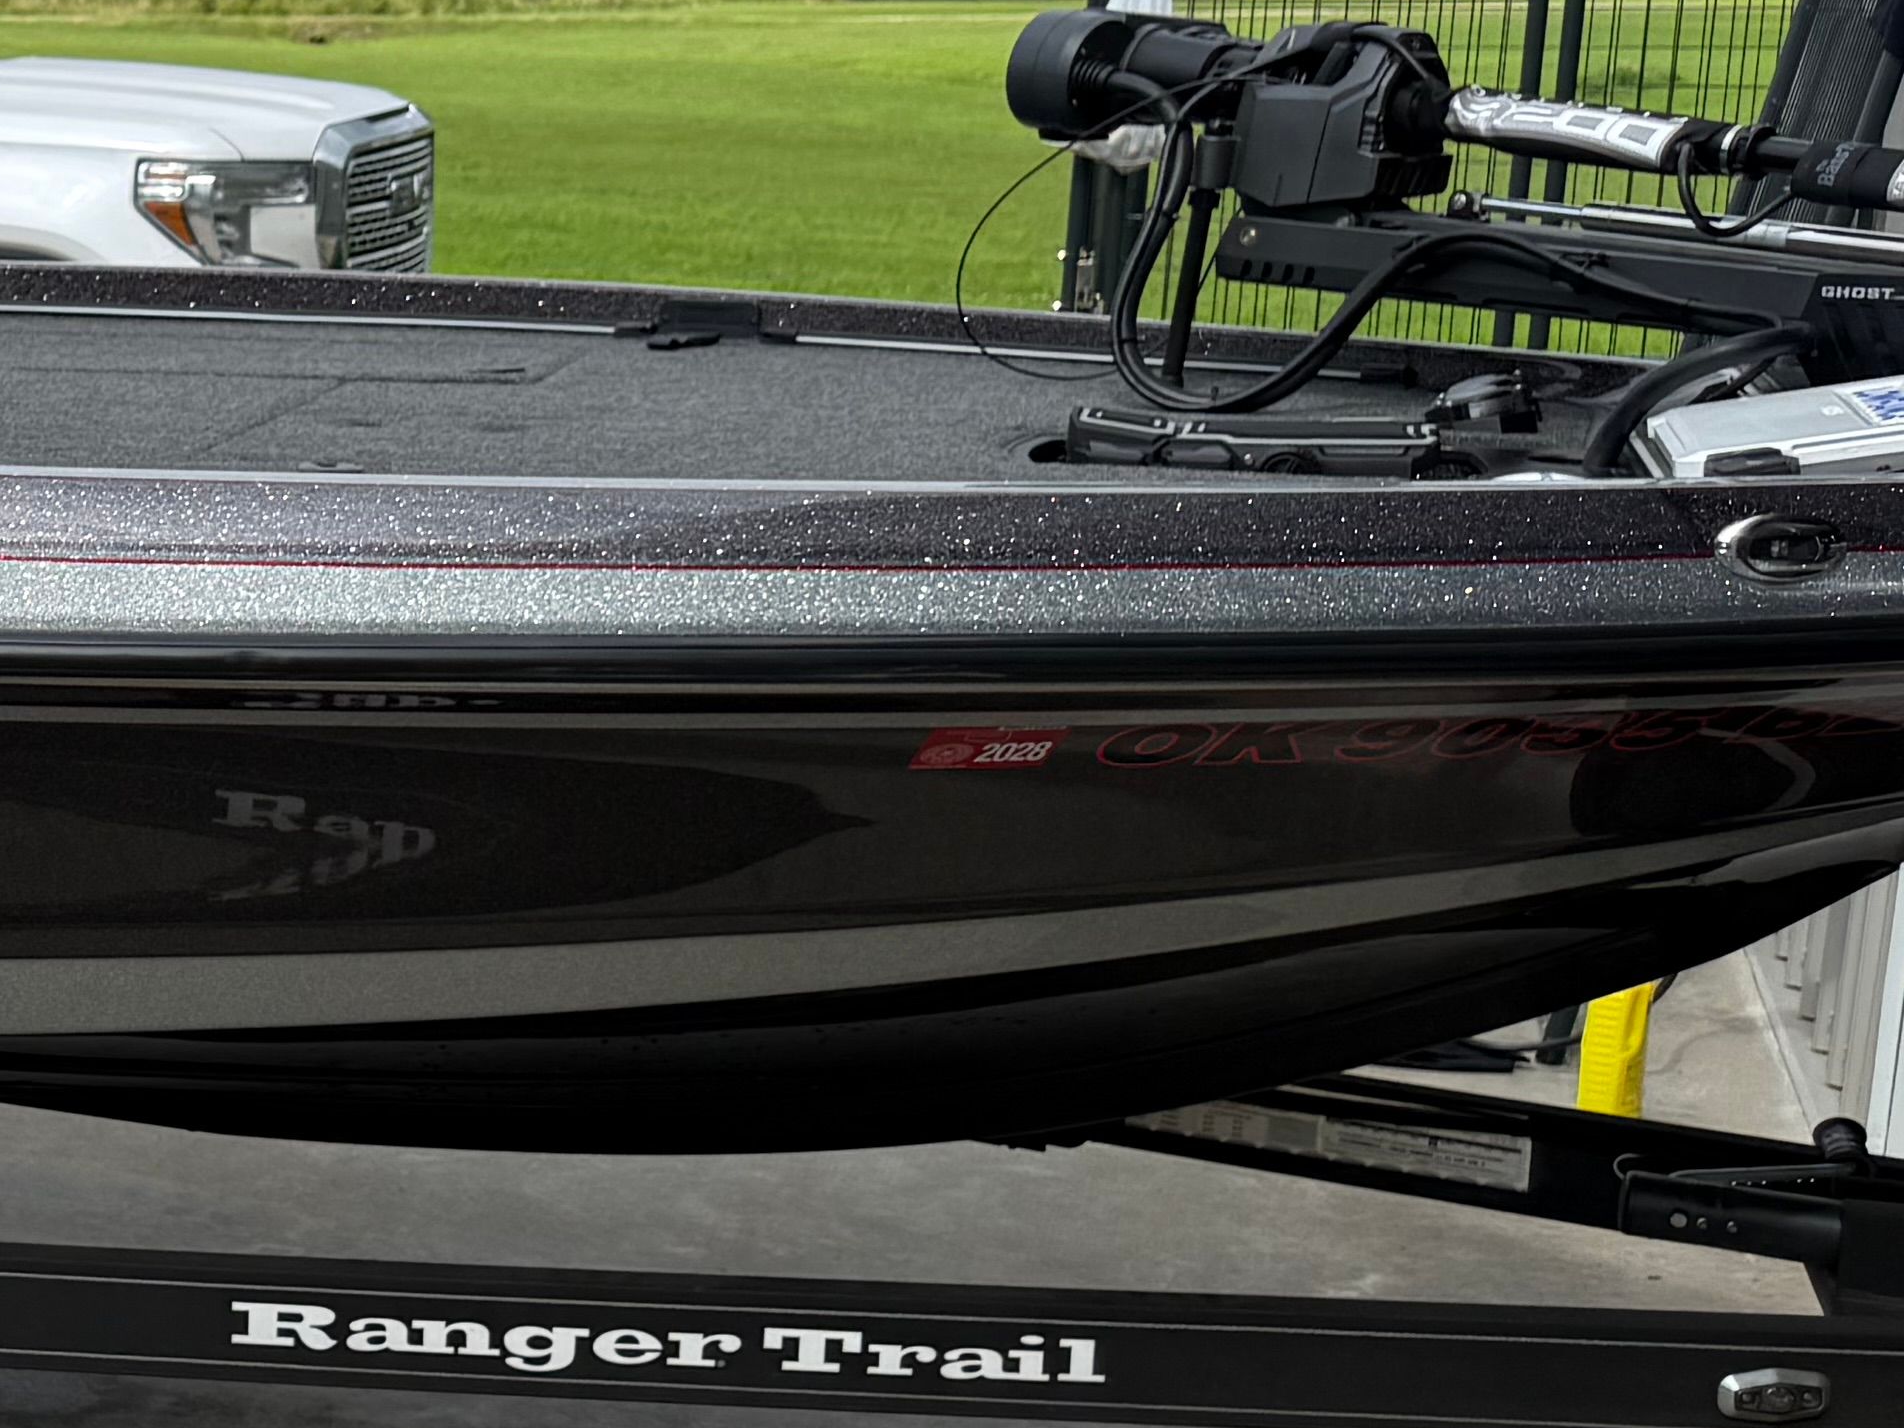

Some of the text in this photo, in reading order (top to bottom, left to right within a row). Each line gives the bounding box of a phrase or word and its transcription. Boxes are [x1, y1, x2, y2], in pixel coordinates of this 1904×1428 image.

[1821, 285, 1896, 301] GHOST
[973, 740, 1053, 764] 2028
[1098, 721, 1324, 769] OK
[229, 1300, 1108, 1384] Ranger Trail
